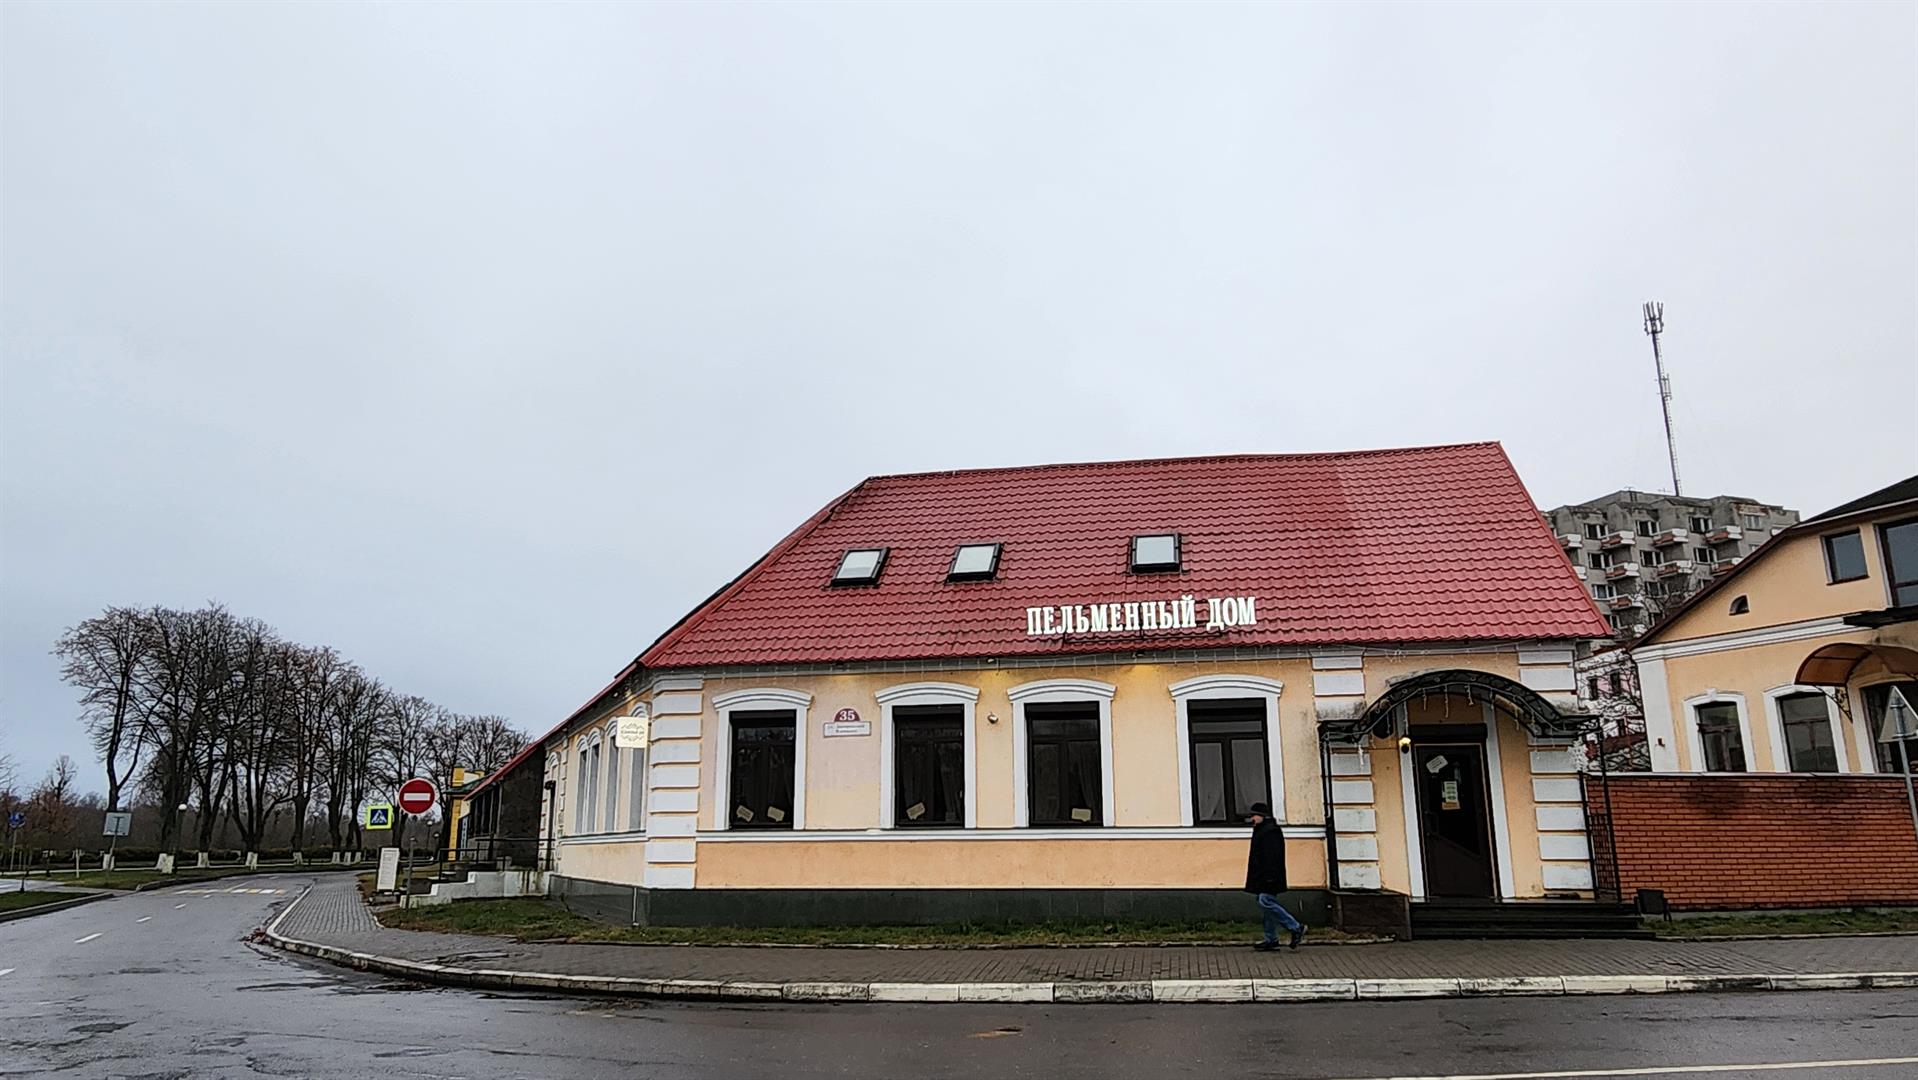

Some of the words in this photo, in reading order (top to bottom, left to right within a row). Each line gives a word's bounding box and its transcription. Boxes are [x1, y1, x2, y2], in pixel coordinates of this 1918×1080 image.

[1026, 595, 1197, 635] ПЕЛЬМЕННЫЙ
[1206, 597, 1257, 631] ДОМ
[839, 710, 856, 721] 35
